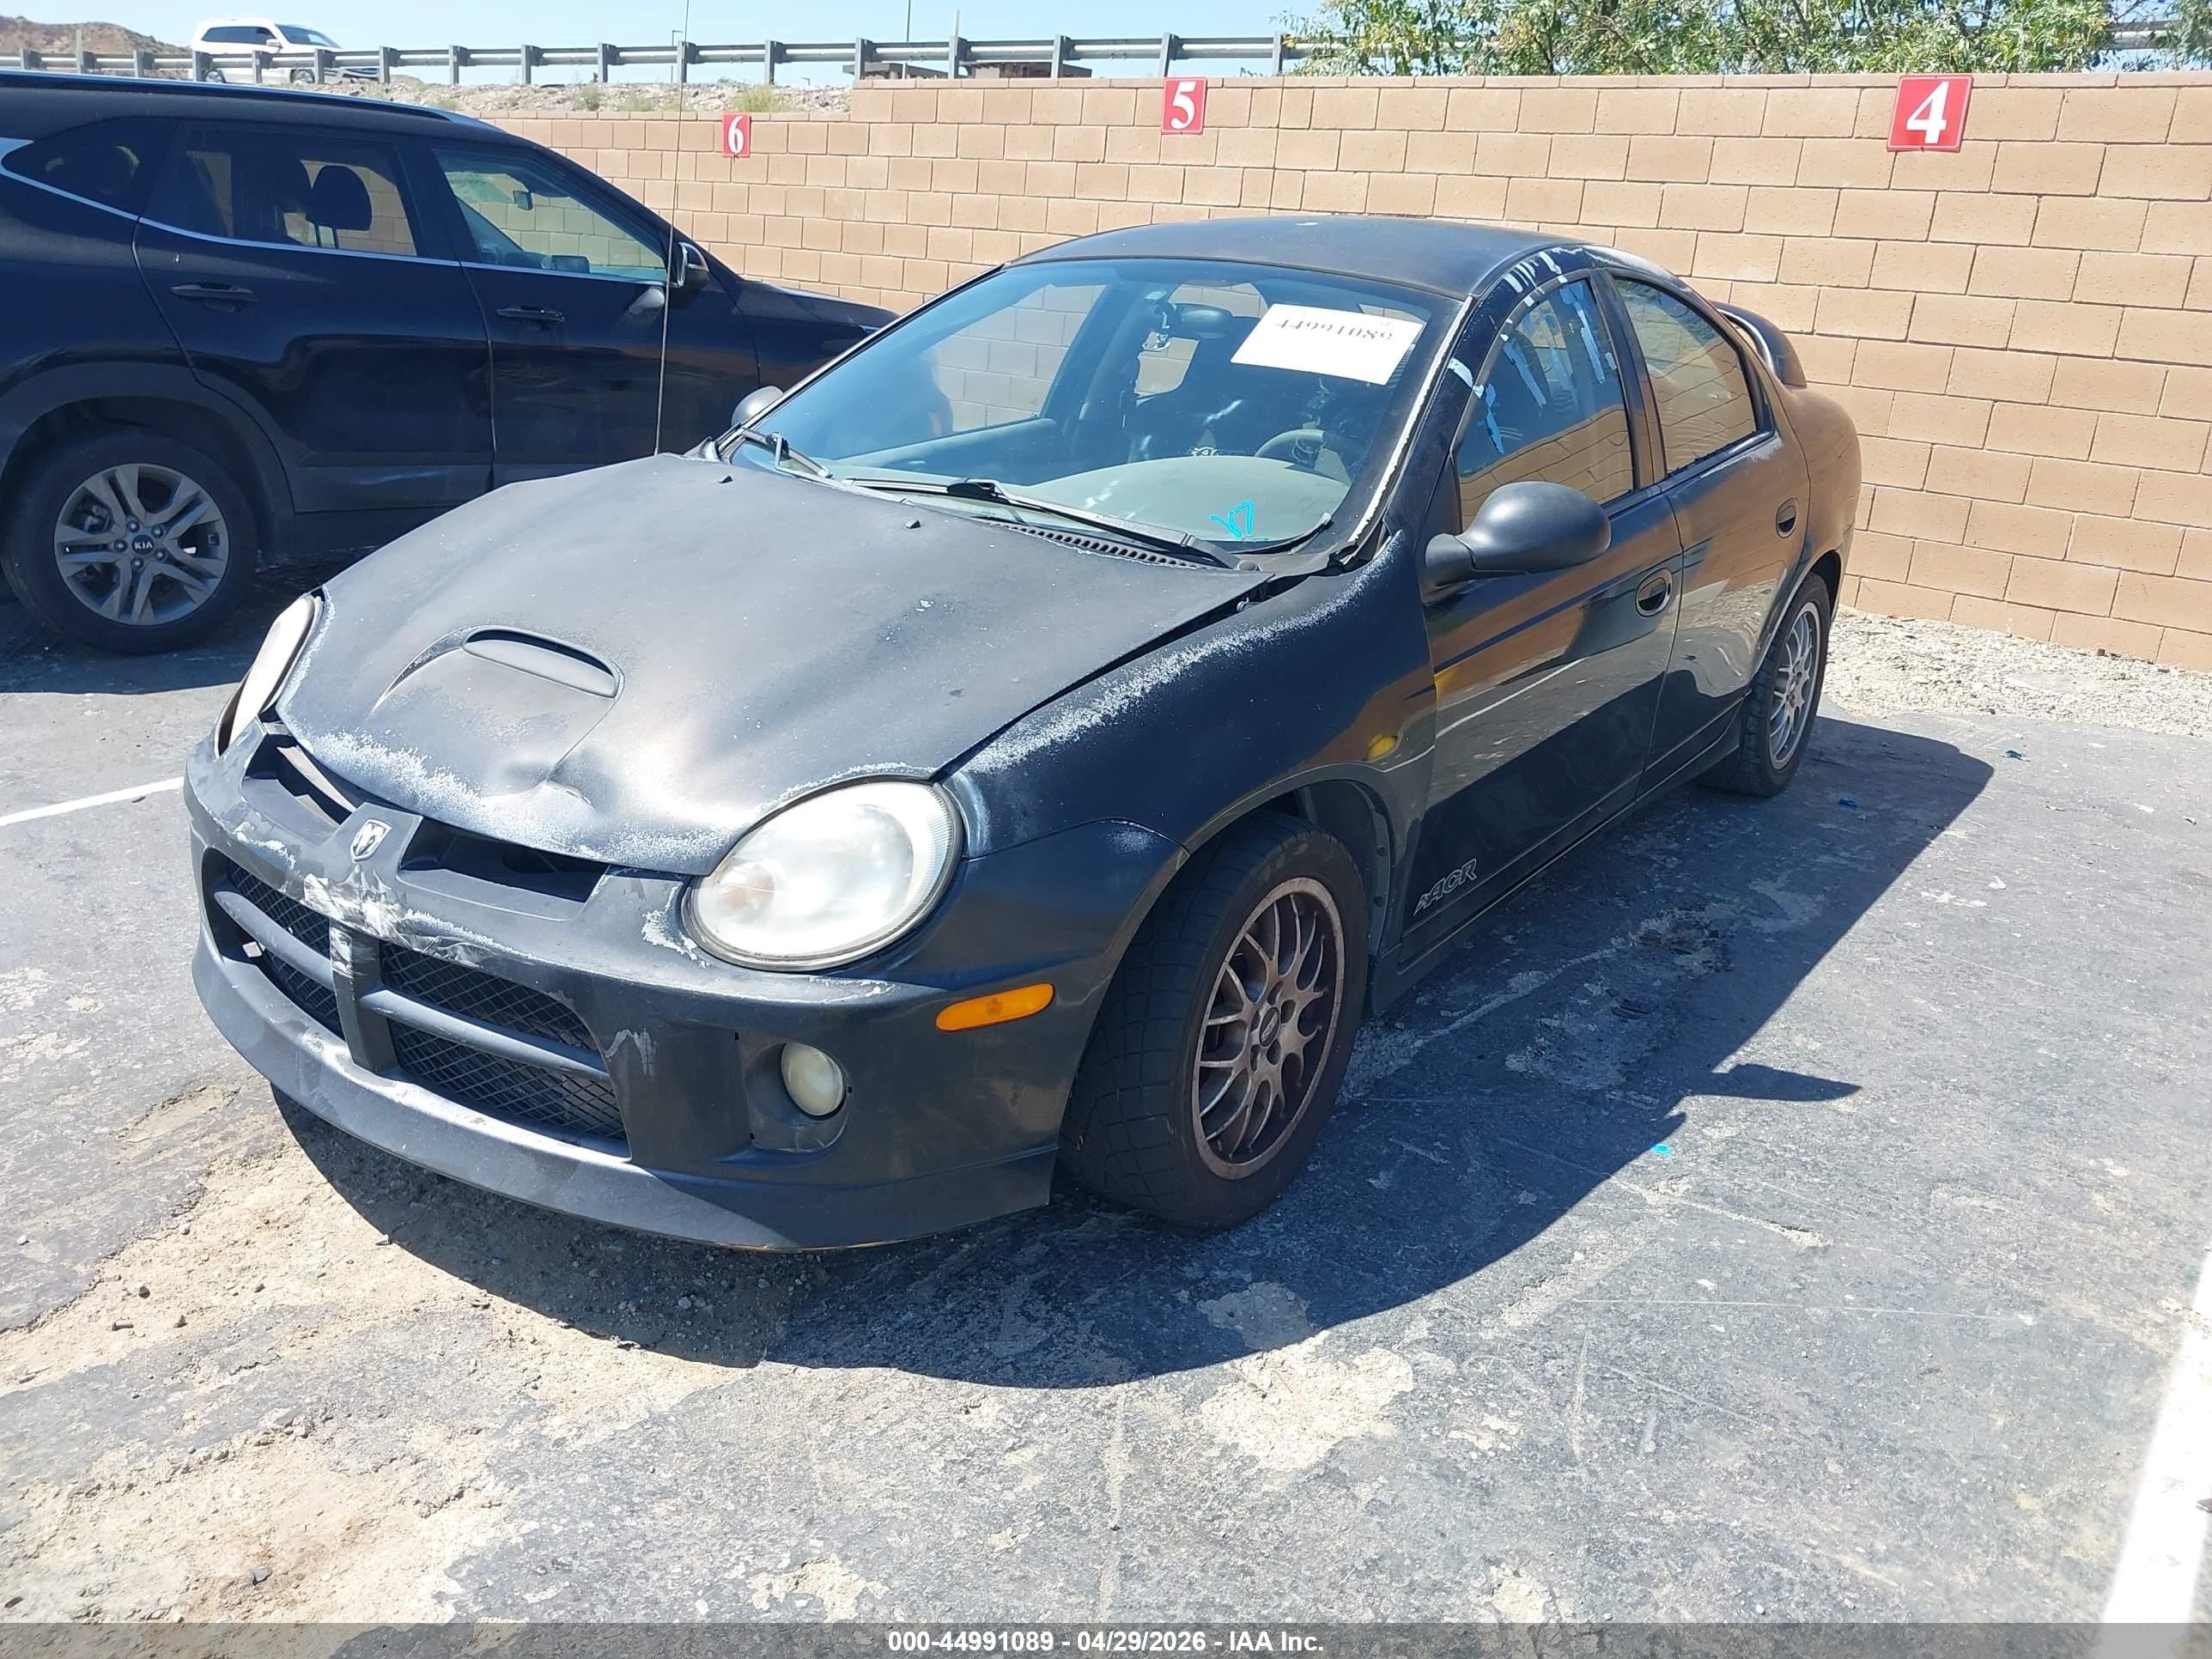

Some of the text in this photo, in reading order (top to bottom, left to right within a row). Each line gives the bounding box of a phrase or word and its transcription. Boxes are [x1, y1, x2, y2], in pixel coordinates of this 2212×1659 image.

[1170, 81, 1196, 130] 5
[1906, 81, 1949, 144] 4
[728, 115, 744, 155] 6
[134, 541, 153, 550] KIA
